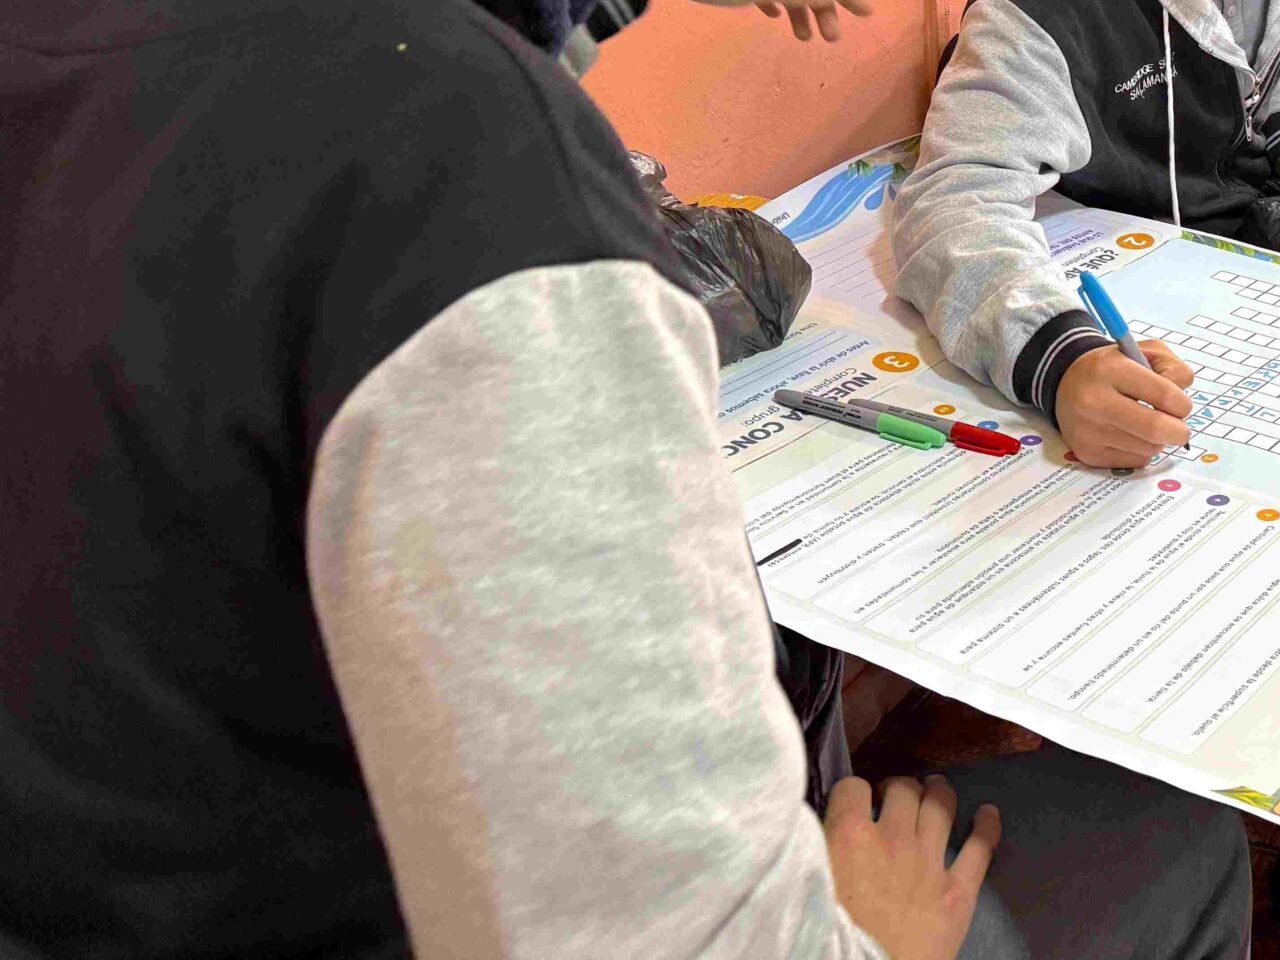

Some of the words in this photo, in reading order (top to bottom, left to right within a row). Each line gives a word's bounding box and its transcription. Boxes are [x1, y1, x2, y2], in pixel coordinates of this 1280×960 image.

[1130, 67, 1178, 100] SALAMANA
[1082, 249, 1119, 269] ¿QUÉ
[814, 356, 837, 366] abrir
[881, 356, 911, 368] 3
[784, 369, 812, 380] llave,
[761, 380, 788, 393] ahora
[724, 392, 764, 412] sabemos
[744, 405, 782, 427] grupo:
[1228, 550, 1244, 562] agua
[1218, 562, 1230, 571] que
[1266, 579, 1280, 591] agua
[1251, 591, 1270, 605] dulce
[1169, 599, 1188, 614] punto
[1240, 604, 1254, 615] que
[1159, 614, 1172, 623] del
[1150, 623, 1160, 631] río
[1201, 622, 1236, 652] encuentran
[1093, 646, 1136, 679] determinado
[1179, 652, 1204, 672] debajo
[1251, 659, 1273, 677] desde
[1171, 672, 1183, 680] de
[1067, 679, 1096, 700] tiempo.
[1146, 686, 1168, 703] tierra.
[1216, 684, 1247, 712] superficie
[1191, 719, 1212, 736] suelo.
